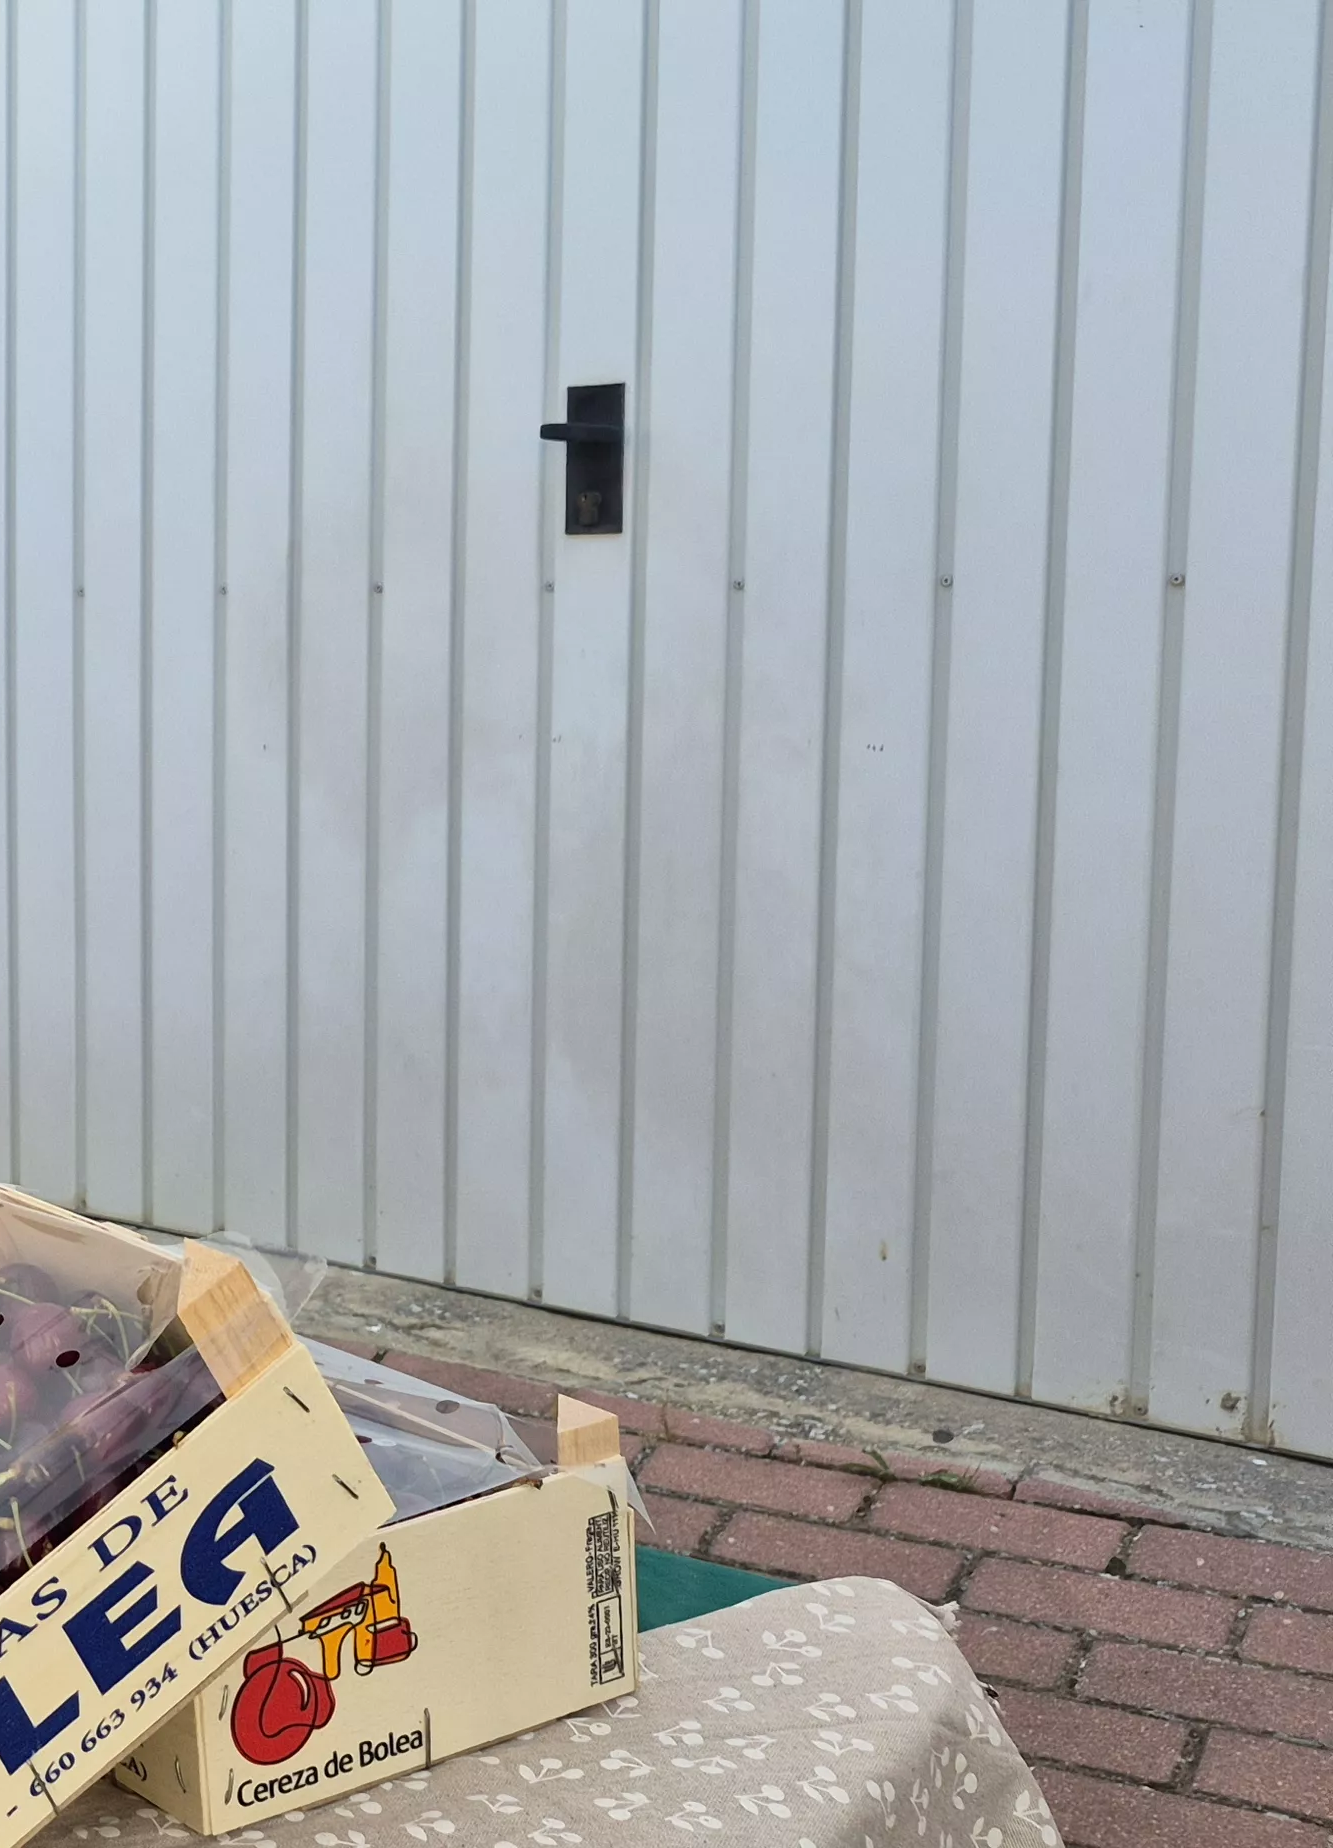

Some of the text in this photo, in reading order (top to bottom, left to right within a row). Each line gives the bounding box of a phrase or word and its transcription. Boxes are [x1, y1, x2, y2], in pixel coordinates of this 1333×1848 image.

[87, 1475, 189, 1572] DE
[81, 1708, 126, 1753] 663
[130, 1662, 178, 1713] 934
[188, 1544, 317, 1660] (HUESCA)
[589, 1641, 597, 1659] 300
[590, 1660, 598, 1687] TARA
[237, 1729, 423, 1807] Cereza de Bolea
